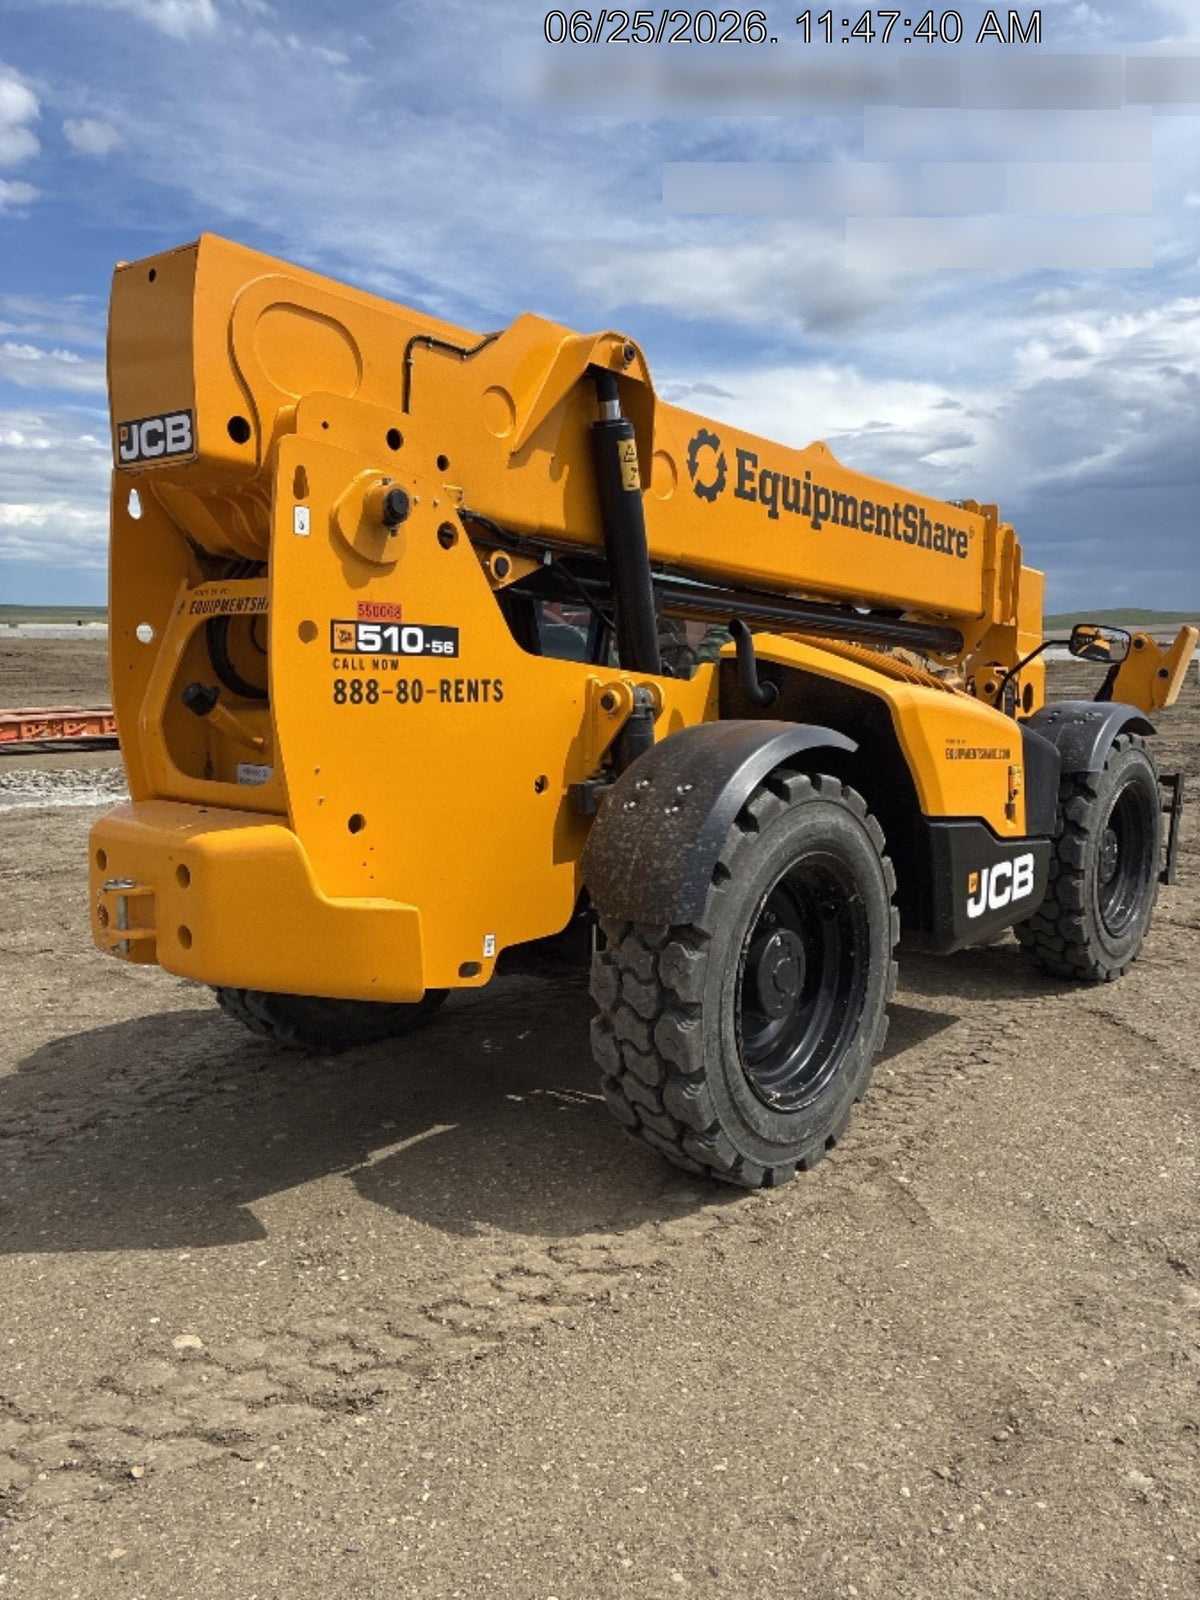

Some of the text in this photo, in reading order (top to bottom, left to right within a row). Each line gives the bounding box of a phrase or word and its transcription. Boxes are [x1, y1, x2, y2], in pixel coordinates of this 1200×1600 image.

[120, 414, 192, 460] JCB
[734, 447, 969, 559] EquipmentShare
[332, 658, 399, 671] CALL NOW
[333, 678, 504, 704] 888-80-RENTS
[967, 853, 1034, 918] JCB
